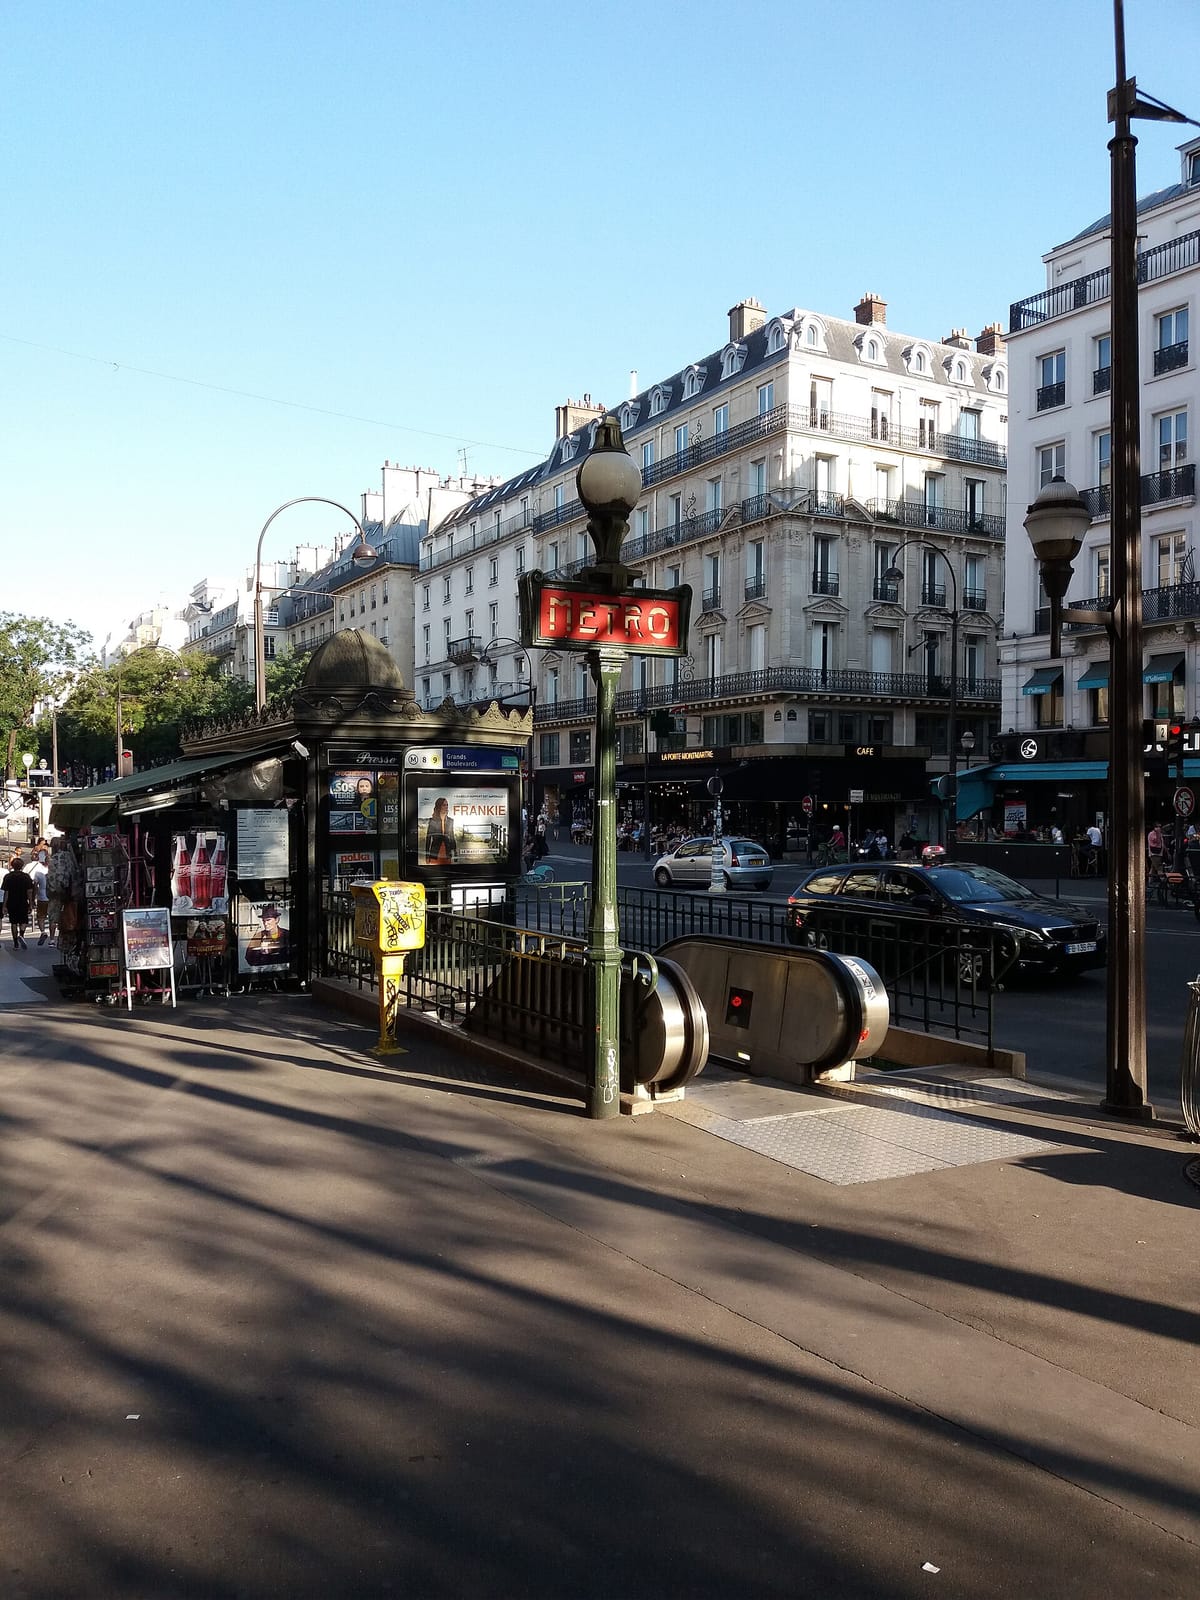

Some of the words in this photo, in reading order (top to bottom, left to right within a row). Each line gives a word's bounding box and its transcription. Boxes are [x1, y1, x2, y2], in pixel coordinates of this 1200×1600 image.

[549, 596, 670, 640] METRO
[356, 751, 397, 765] Presse
[422, 756, 427, 764] 8
[453, 804, 506, 816] FRANKIE
